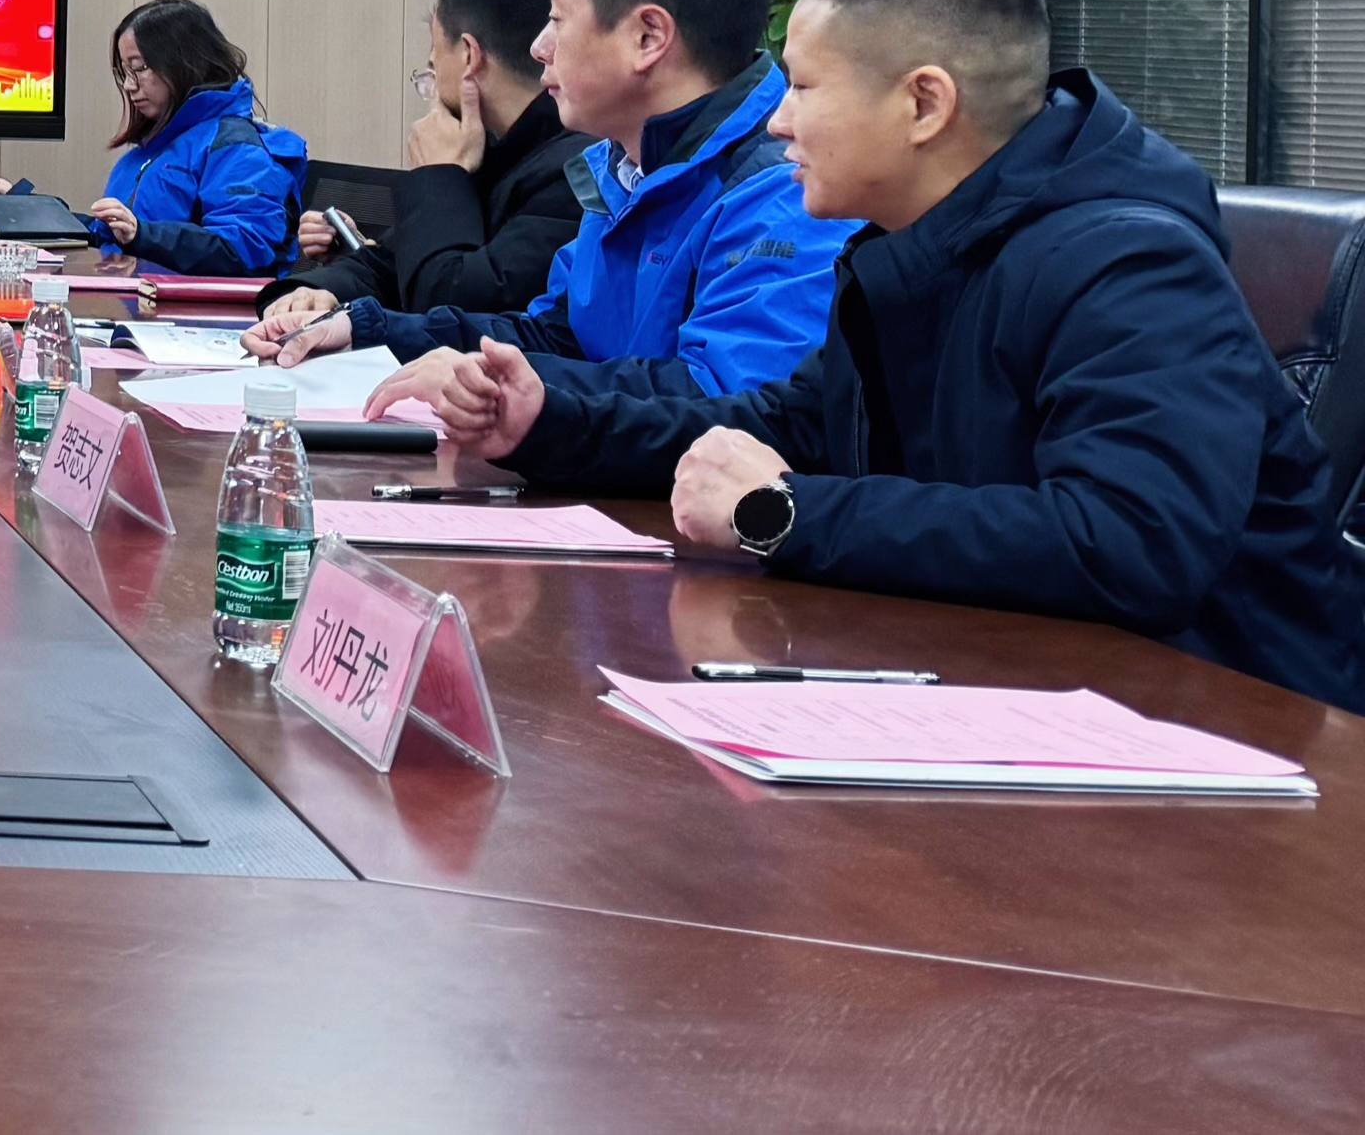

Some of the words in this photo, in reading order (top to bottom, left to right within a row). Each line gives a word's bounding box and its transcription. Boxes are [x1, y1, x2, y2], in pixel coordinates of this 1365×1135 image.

[53, 418, 105, 491] 贺志文
[299, 608, 390, 722] 刘丹龙
